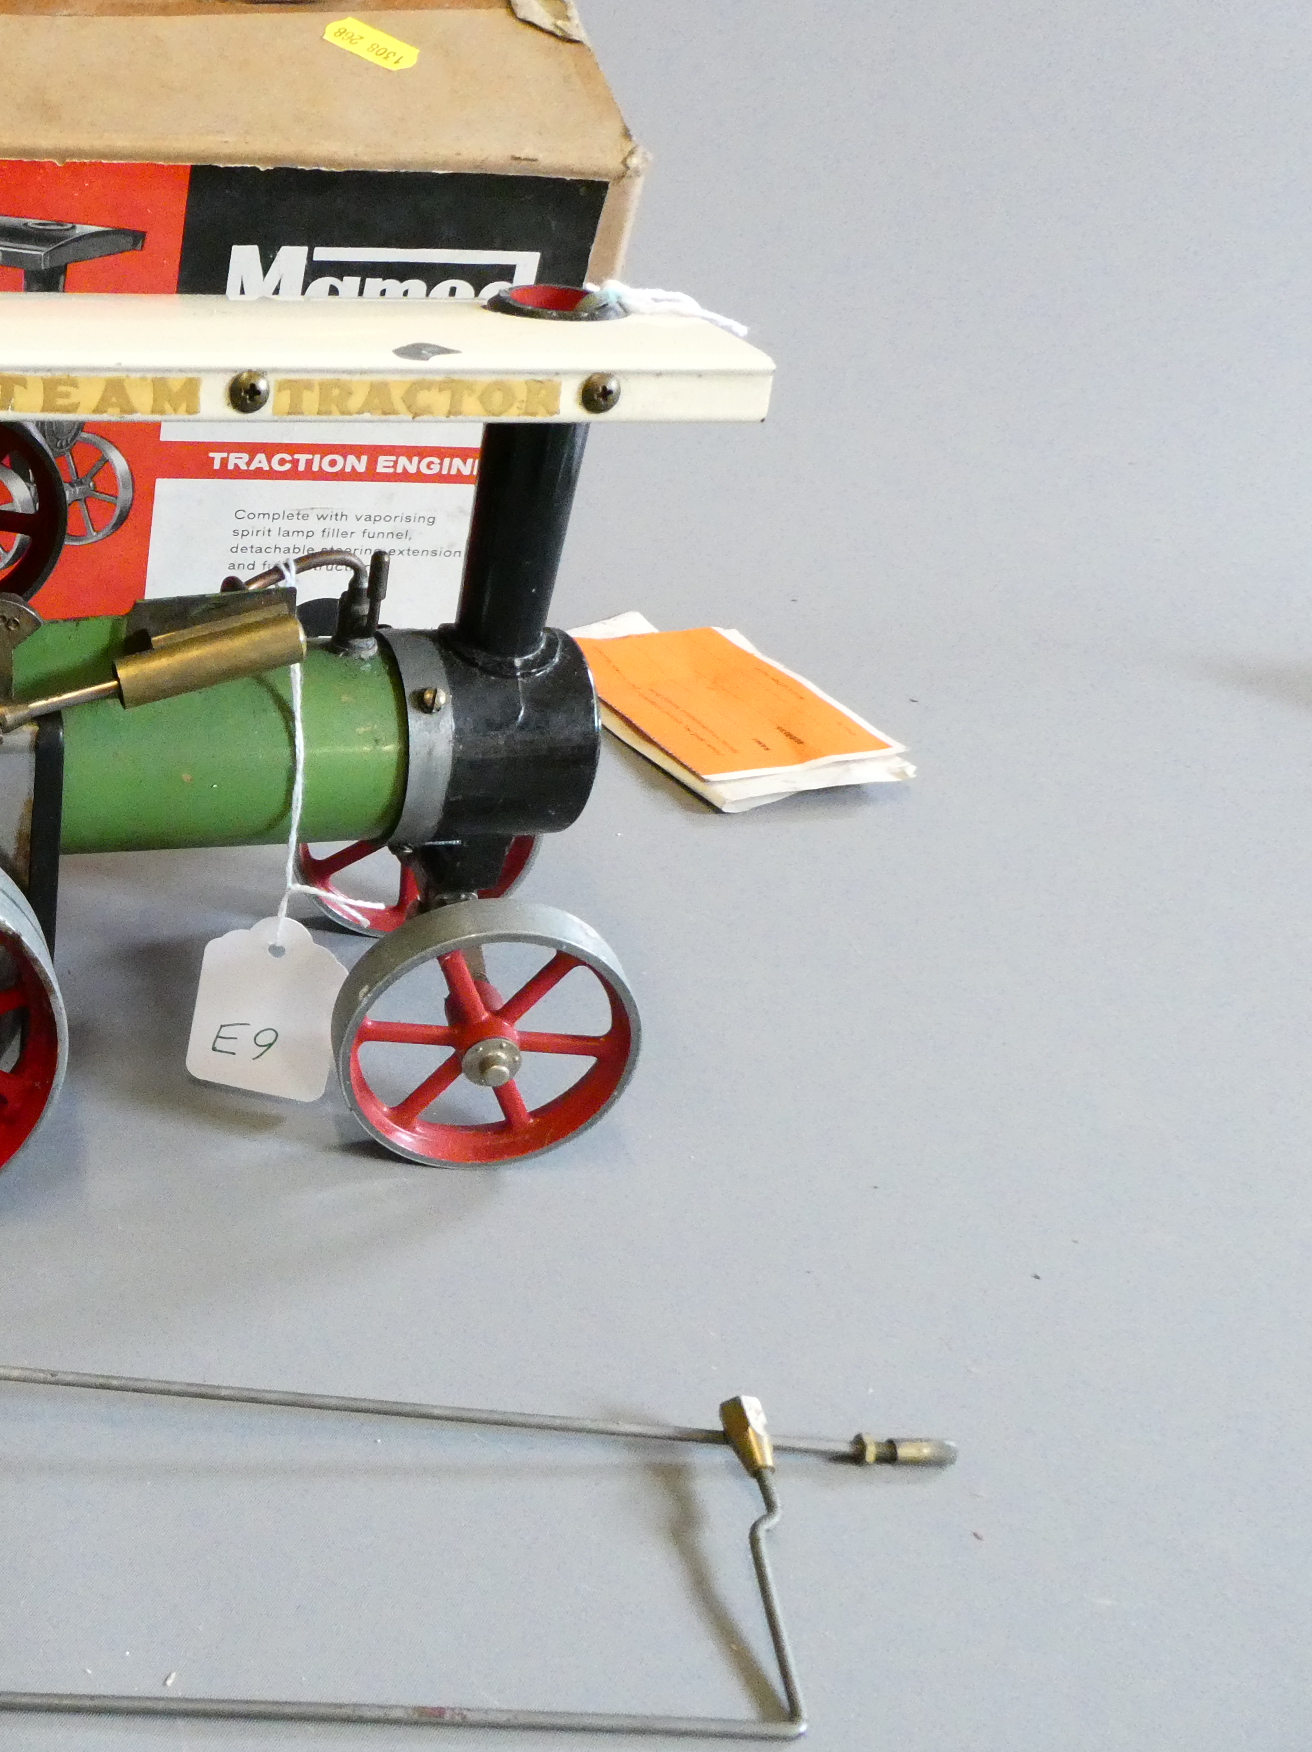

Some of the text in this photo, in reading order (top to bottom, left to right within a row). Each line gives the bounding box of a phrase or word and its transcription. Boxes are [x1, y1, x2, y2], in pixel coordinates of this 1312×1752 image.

[276, 378, 561, 418] TRACTOR
[209, 452, 479, 476] TRACTION ENGIN
[234, 509, 436, 526] Complete with vaporising
[232, 527, 413, 541] spirit lamp filler funnel,
[230, 544, 315, 555] detachable
[389, 547, 462, 558] extension
[228, 561, 256, 571] and
